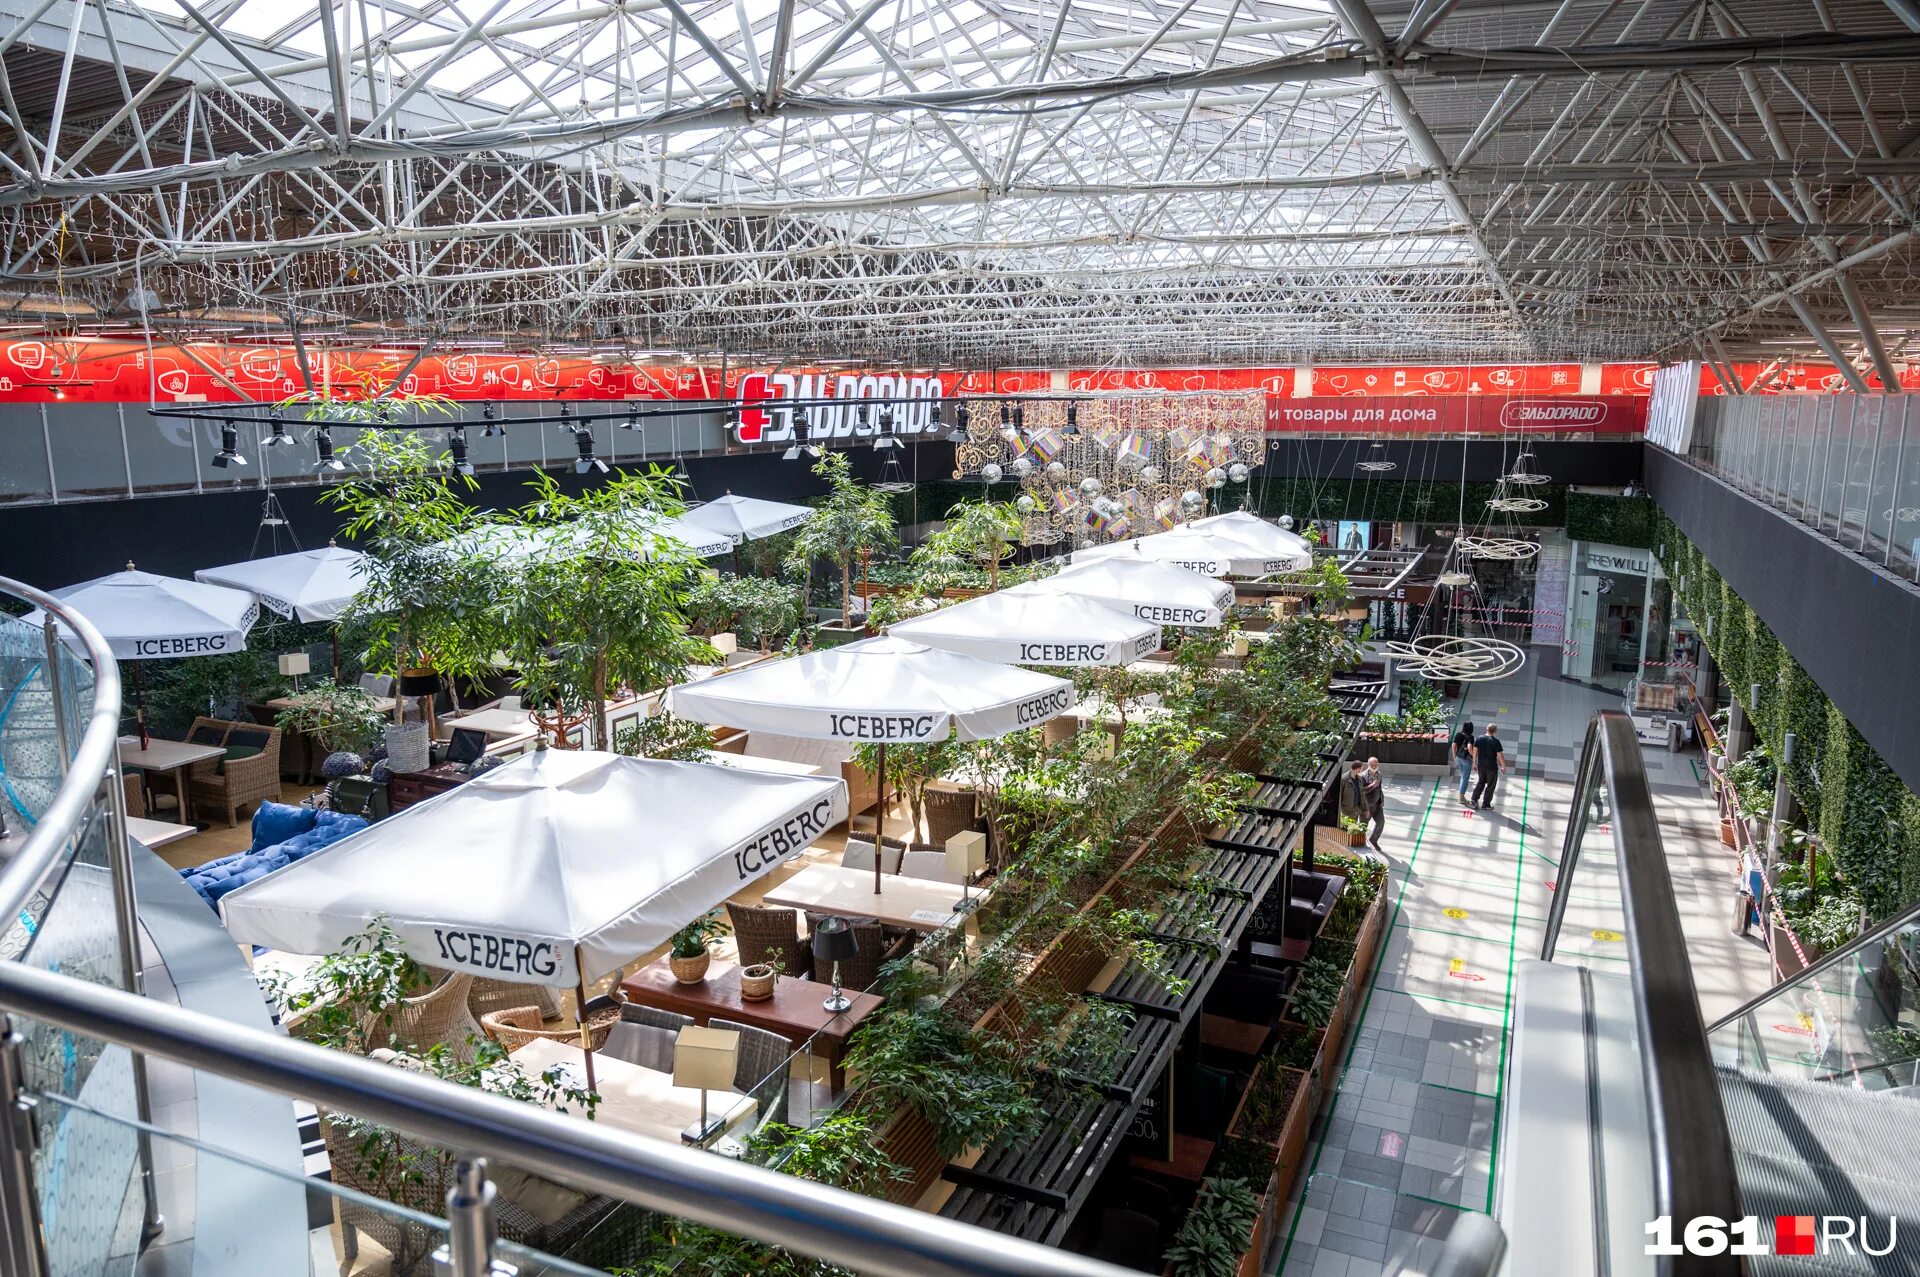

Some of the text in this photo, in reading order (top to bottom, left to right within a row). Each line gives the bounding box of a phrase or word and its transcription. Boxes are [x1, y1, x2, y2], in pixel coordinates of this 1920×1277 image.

[1268, 409, 1279, 420] и
[1284, 409, 1347, 424] товары
[1352, 409, 1385, 423] для
[1389, 409, 1437, 423] дома
[1263, 559, 1292, 573] ICEBERG
[1587, 553, 1648, 573] FREYWILL
[1134, 604, 1207, 623] ICEBERG
[136, 635, 226, 656] ICEBERG
[1020, 643, 1106, 662] ICEBERG
[1015, 688, 1068, 725] ICEBERG
[830, 714, 934, 739] ICEBERG
[434, 929, 556, 977] ICEBERG
